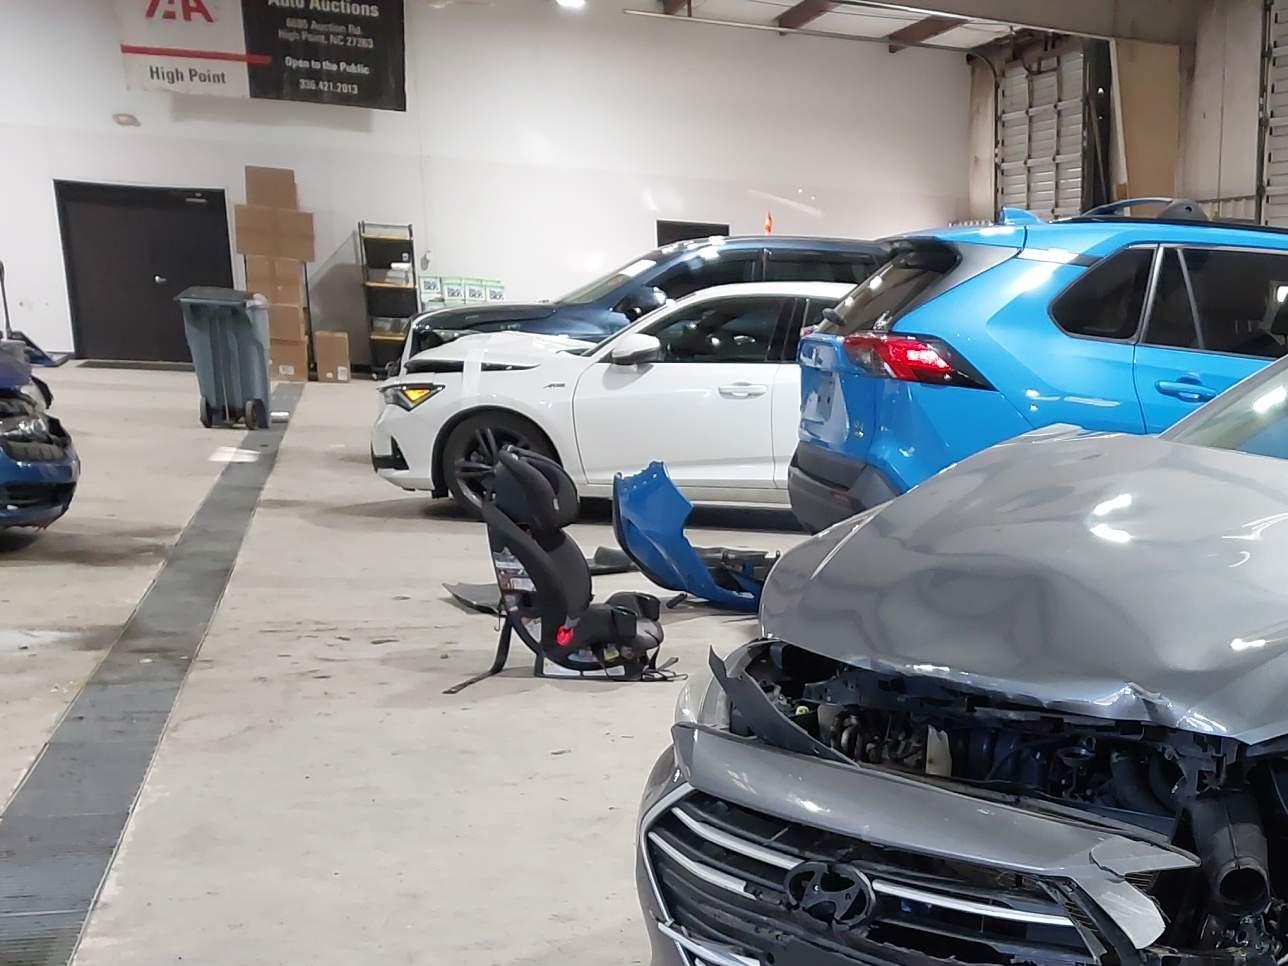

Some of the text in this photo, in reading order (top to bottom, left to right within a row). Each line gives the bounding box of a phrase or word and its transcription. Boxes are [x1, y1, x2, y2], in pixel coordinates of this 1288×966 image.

[309, 0, 379, 17] Auctions
[149, 65, 226, 84] High Point
[285, 56, 310, 69] Open
[340, 61, 370, 75] Public
